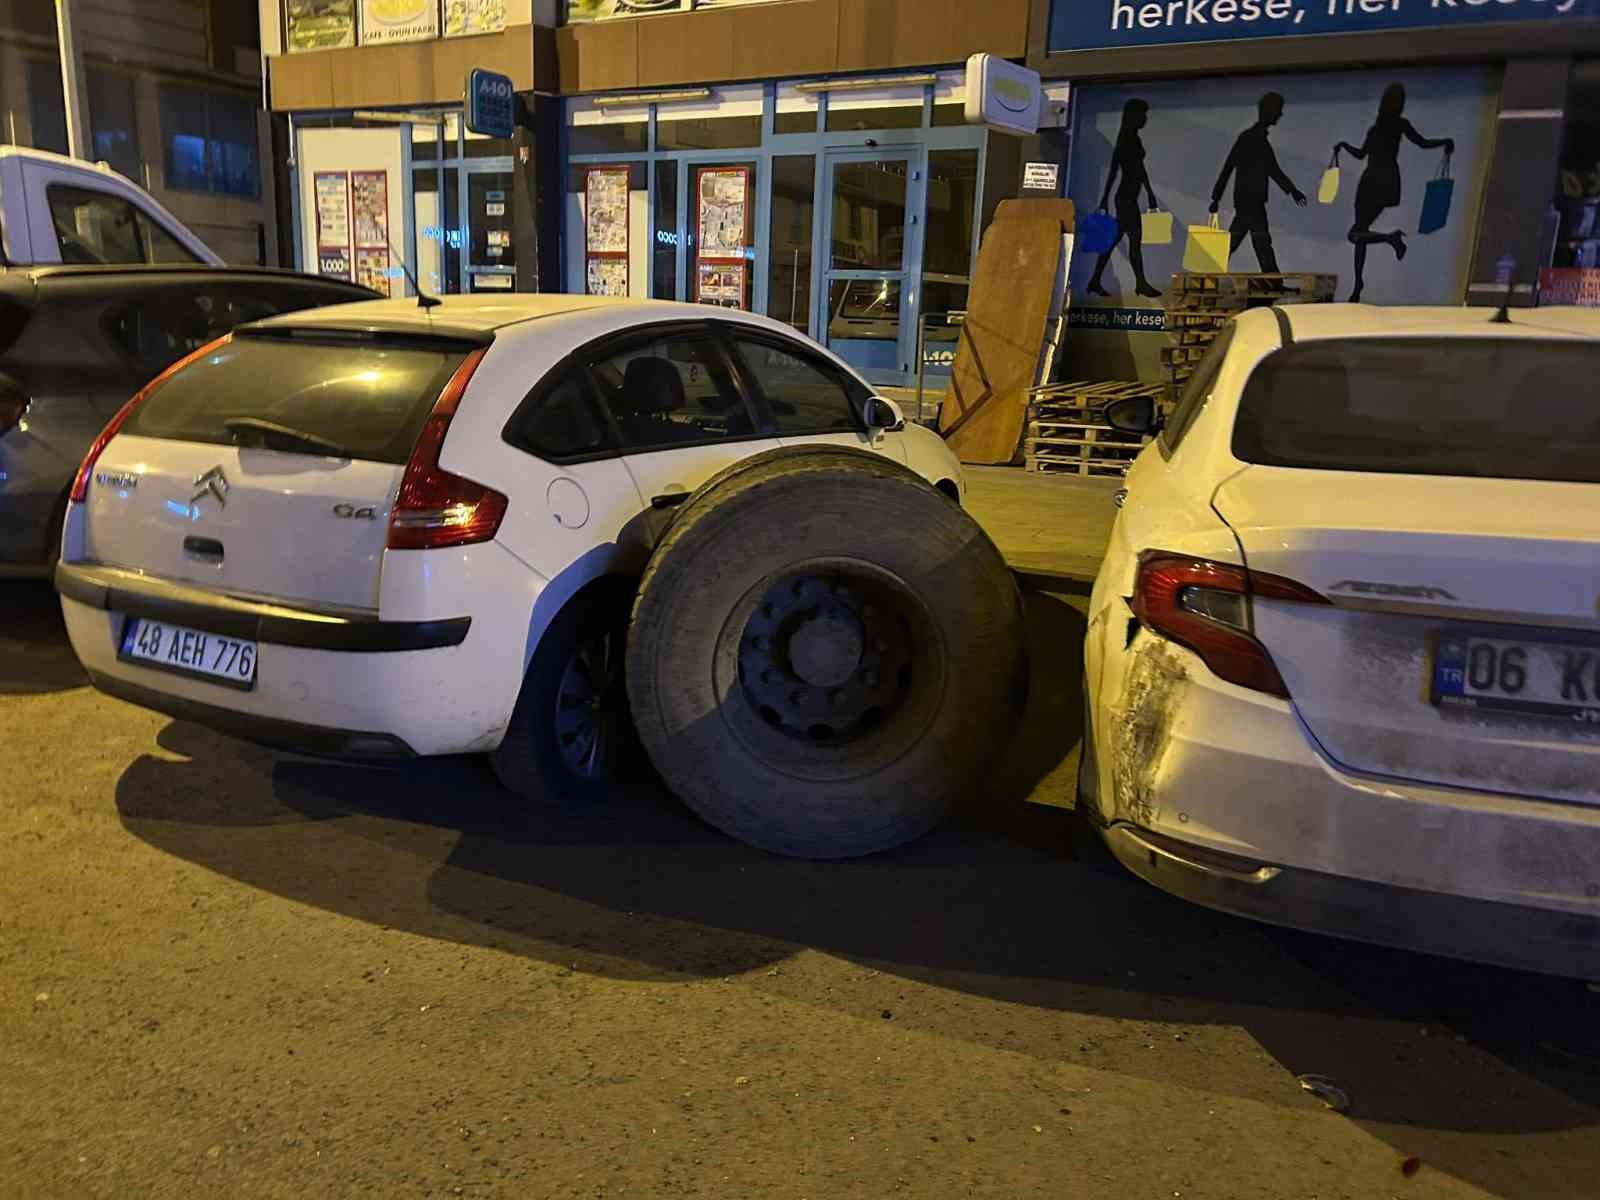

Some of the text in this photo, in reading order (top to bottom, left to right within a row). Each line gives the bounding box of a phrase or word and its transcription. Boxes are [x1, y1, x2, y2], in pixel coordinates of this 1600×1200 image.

[138, 623, 162, 656] 48
[168, 629, 207, 667] AEH
[213, 639, 253, 677] 776
[1470, 642, 1528, 694] 06
[1560, 651, 1600, 702] K
